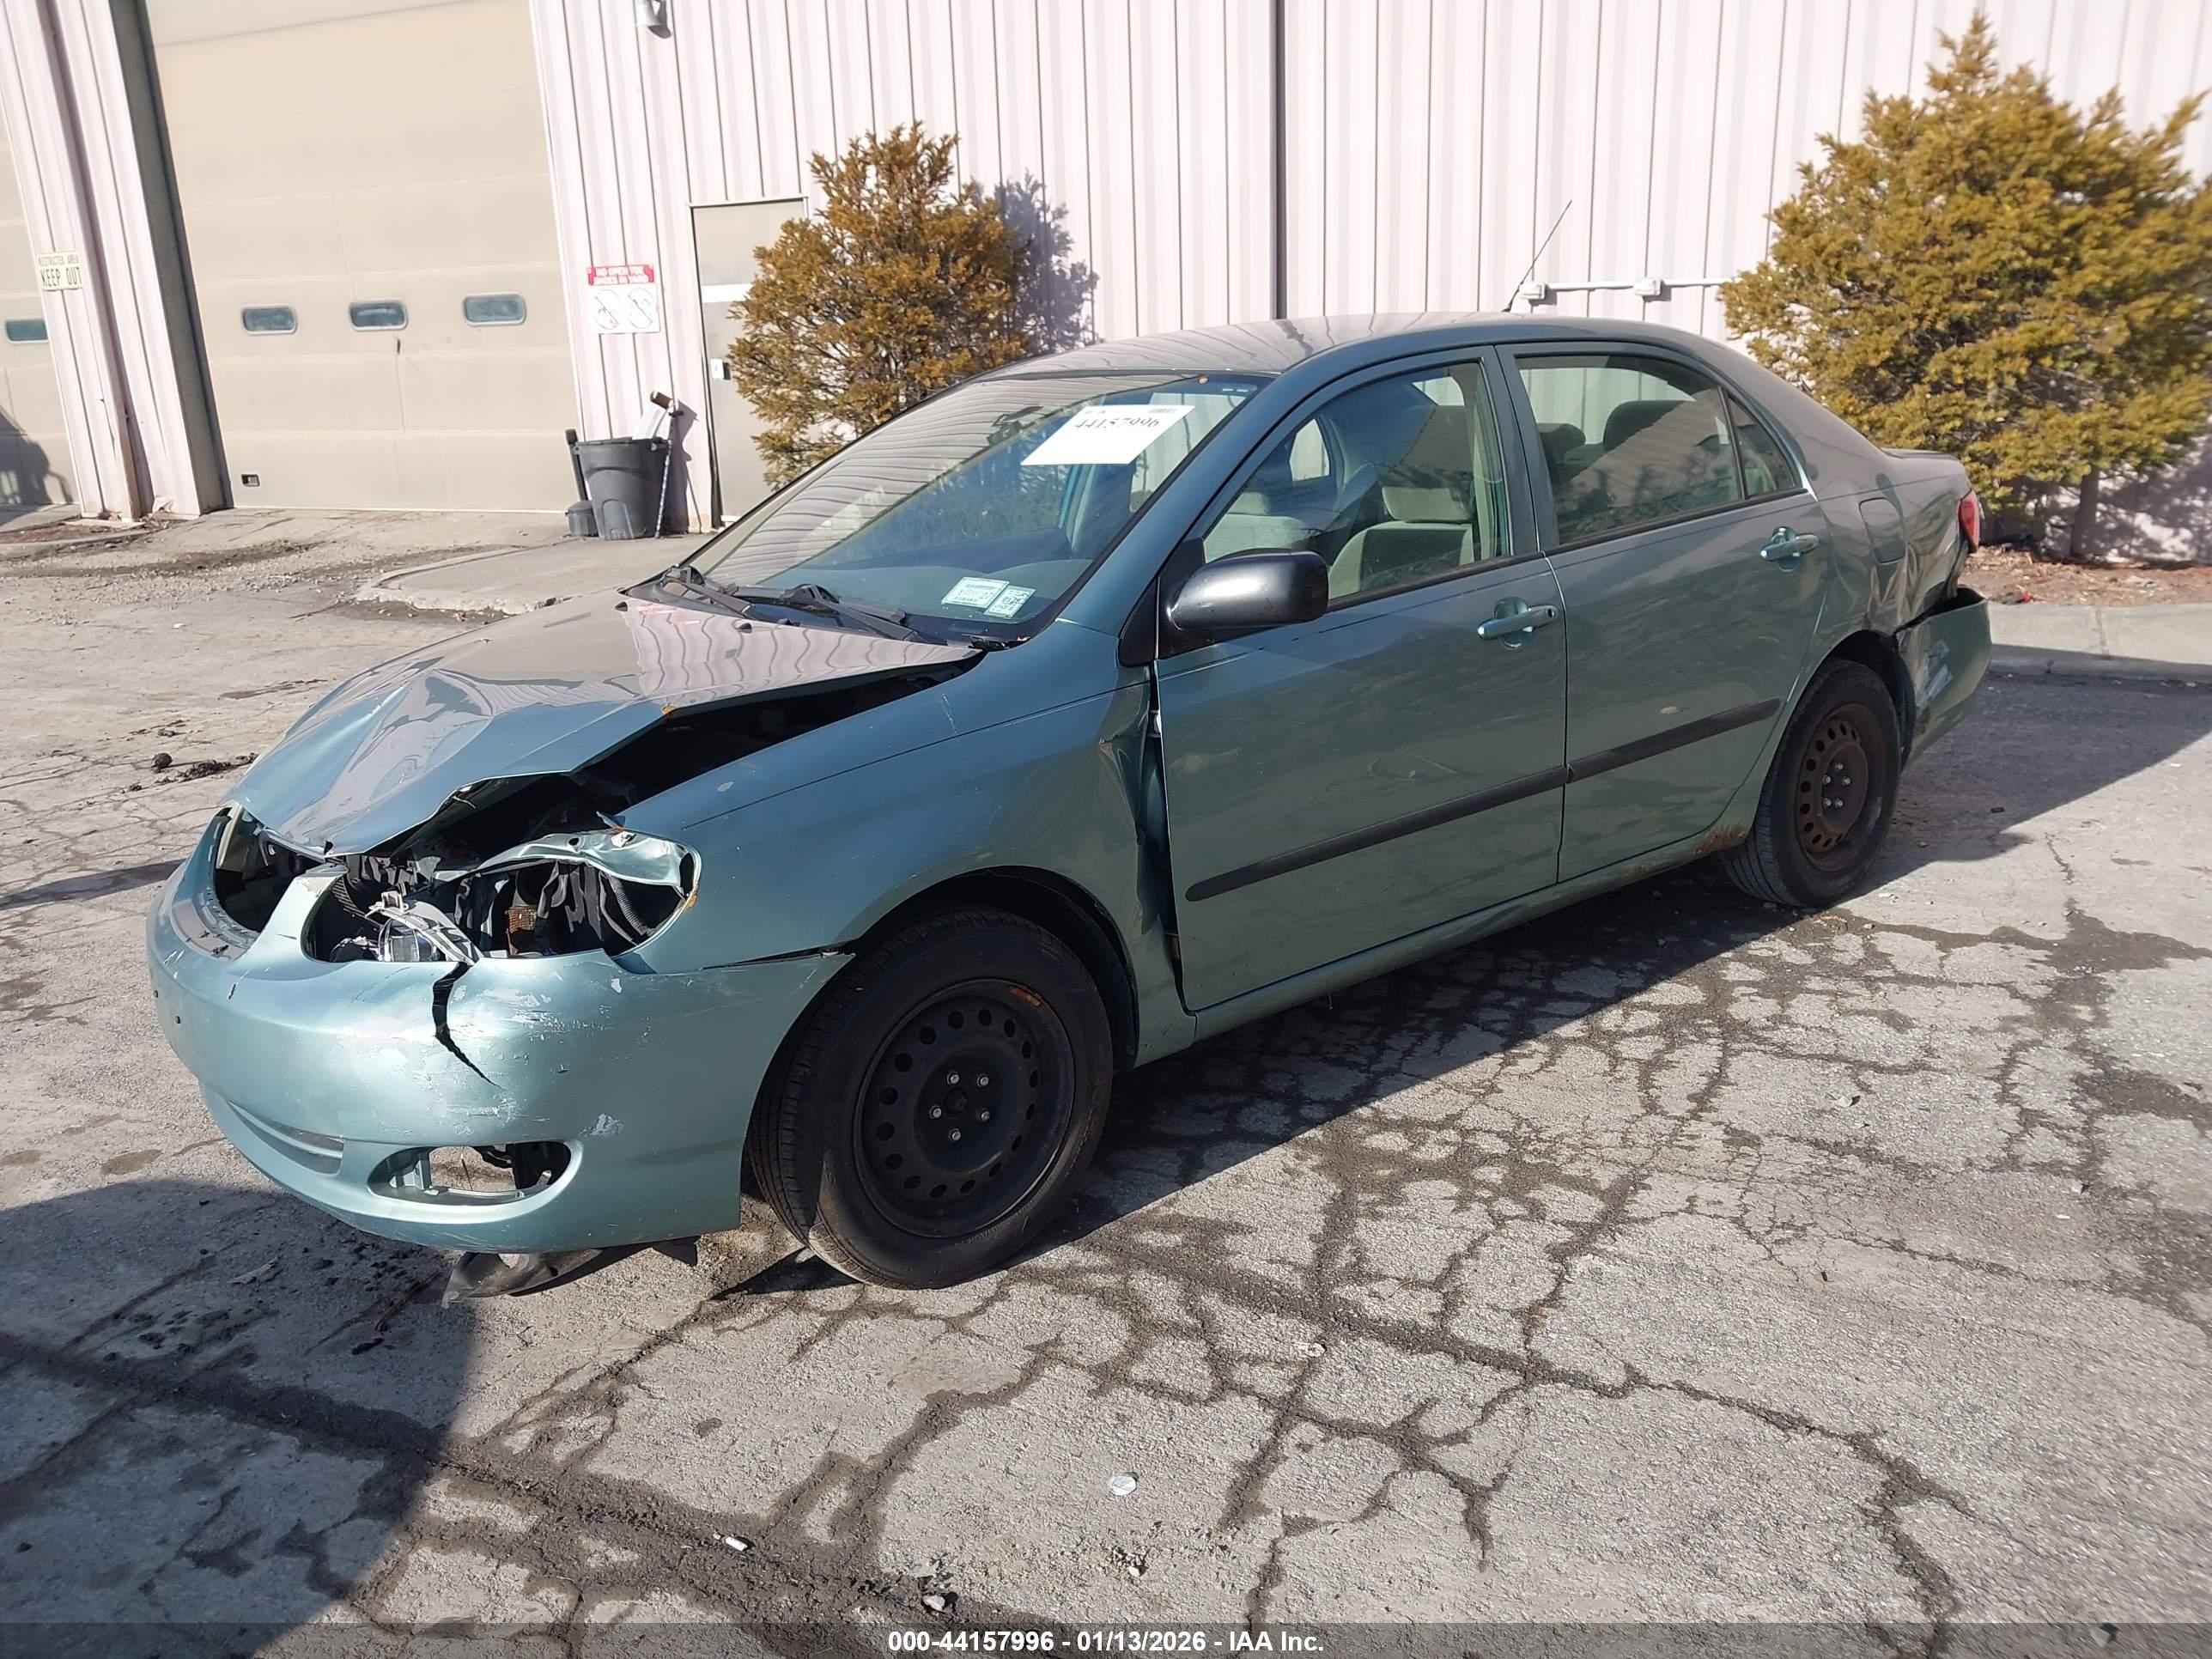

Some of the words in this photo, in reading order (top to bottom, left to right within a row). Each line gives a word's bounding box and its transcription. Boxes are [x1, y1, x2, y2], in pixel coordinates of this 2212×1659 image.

[40, 268, 61, 287] KEEP
[66, 266, 82, 285] OUT
[1073, 417, 1160, 429] 44157996
